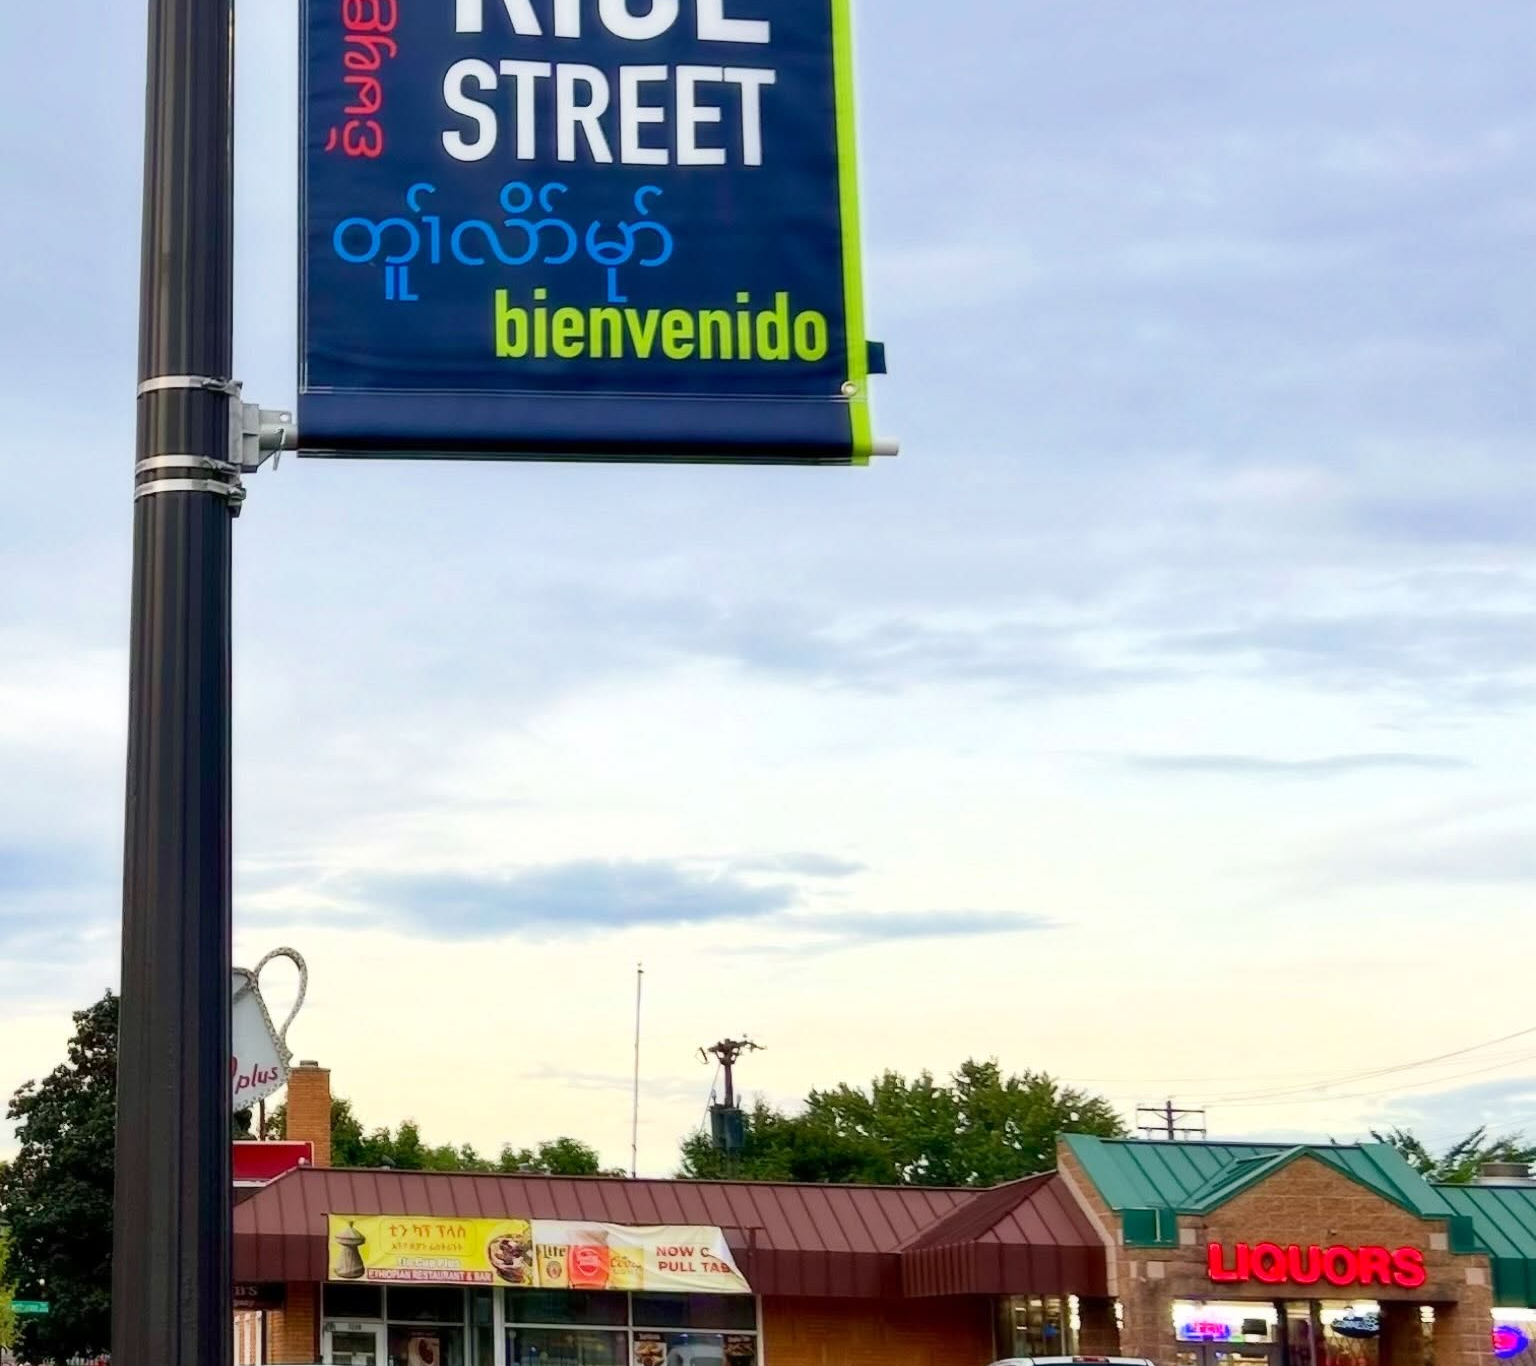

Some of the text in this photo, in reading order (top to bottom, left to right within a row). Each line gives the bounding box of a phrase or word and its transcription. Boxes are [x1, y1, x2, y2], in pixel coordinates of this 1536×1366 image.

[441, 57, 777, 167] STREET
[494, 287, 829, 362] bienvenido
[234, 1062, 279, 1095] plus
[656, 1245, 694, 1257] NOW
[658, 1261, 696, 1272] PULL
[1206, 1241, 1428, 1289] LIQUORS
